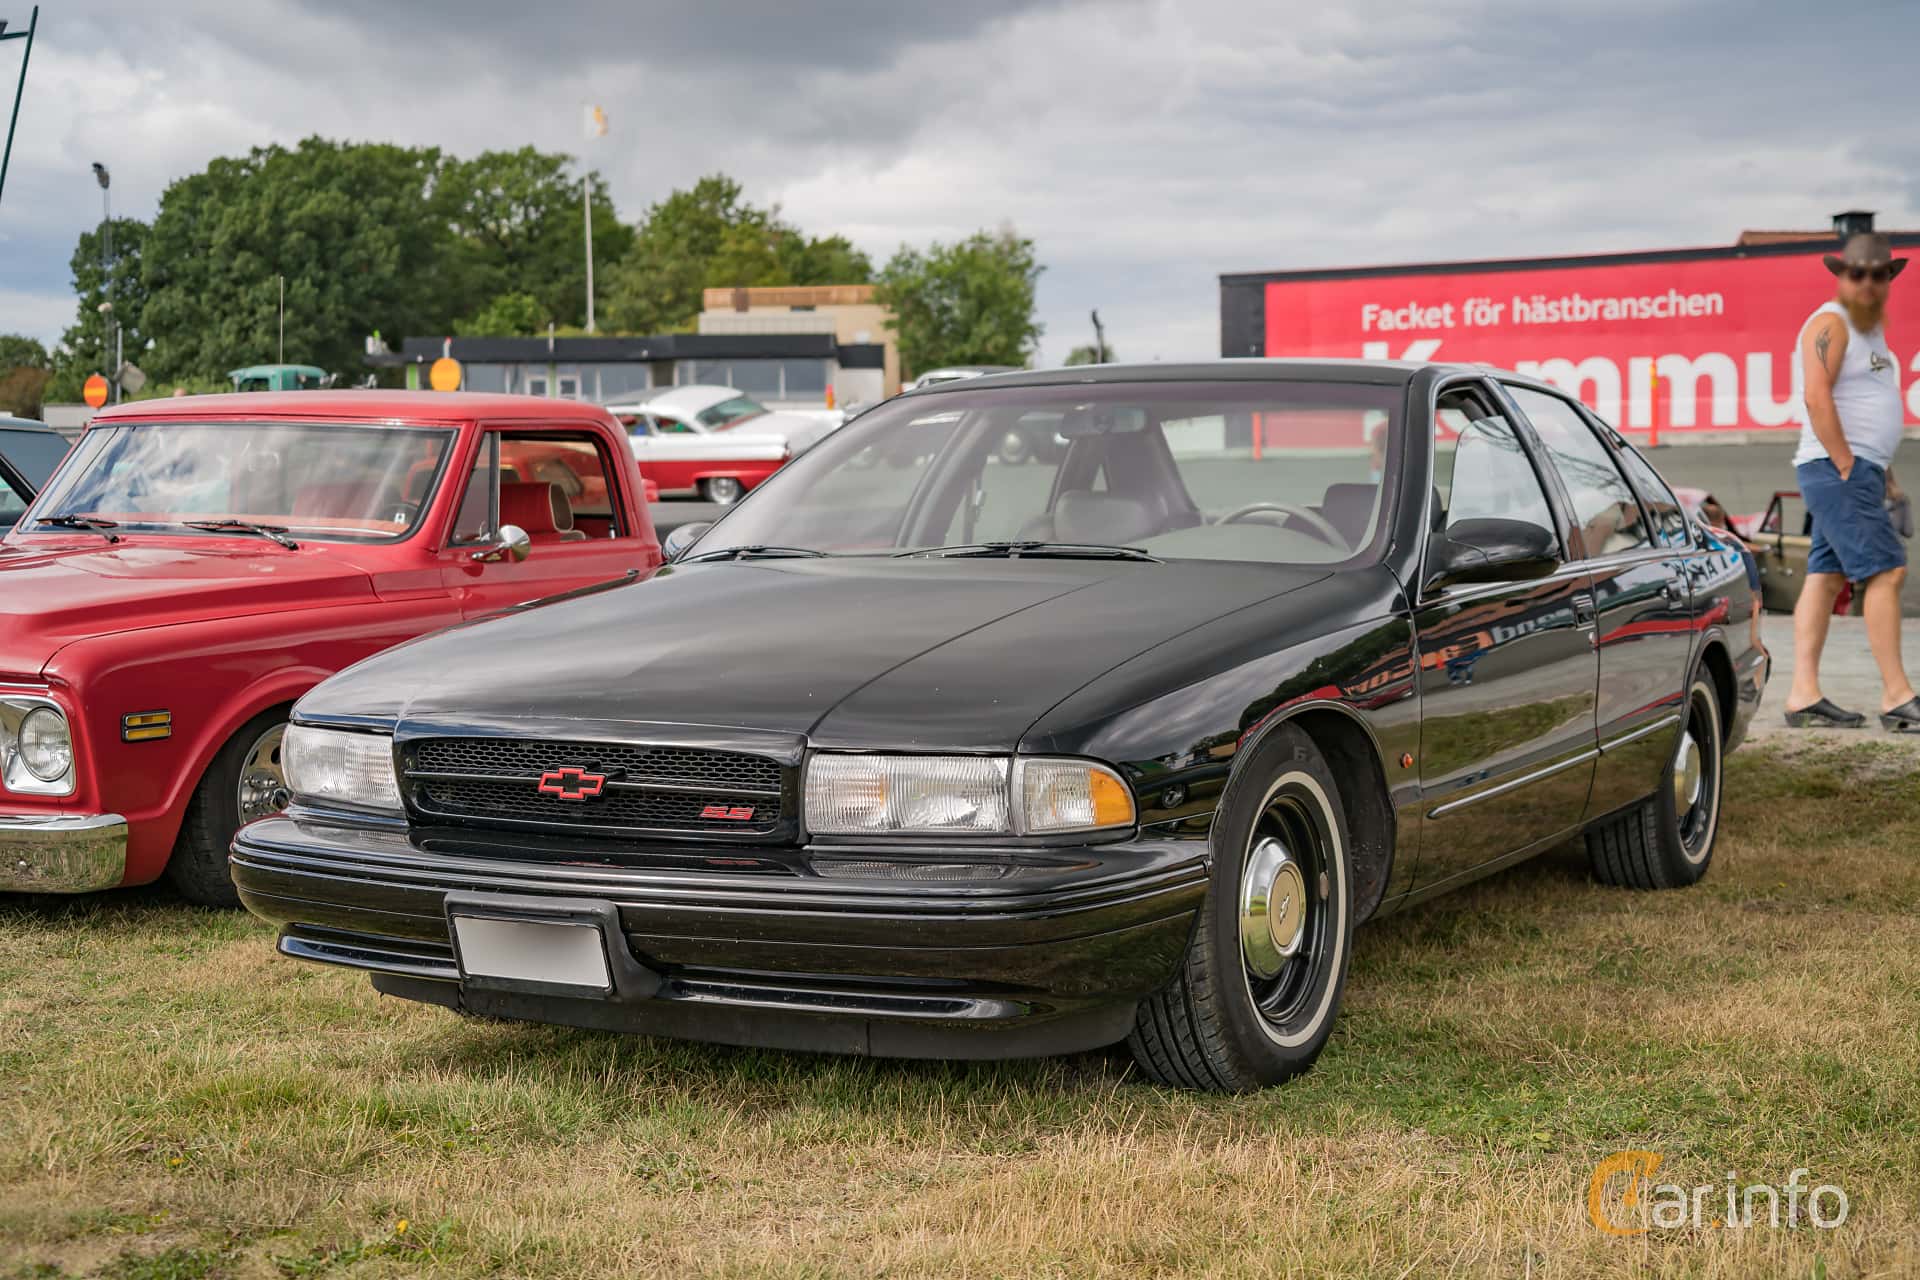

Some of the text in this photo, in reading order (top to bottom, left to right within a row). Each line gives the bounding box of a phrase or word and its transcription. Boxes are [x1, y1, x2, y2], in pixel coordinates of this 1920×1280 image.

[1361, 289, 1724, 332] Facket för hästbranschen
